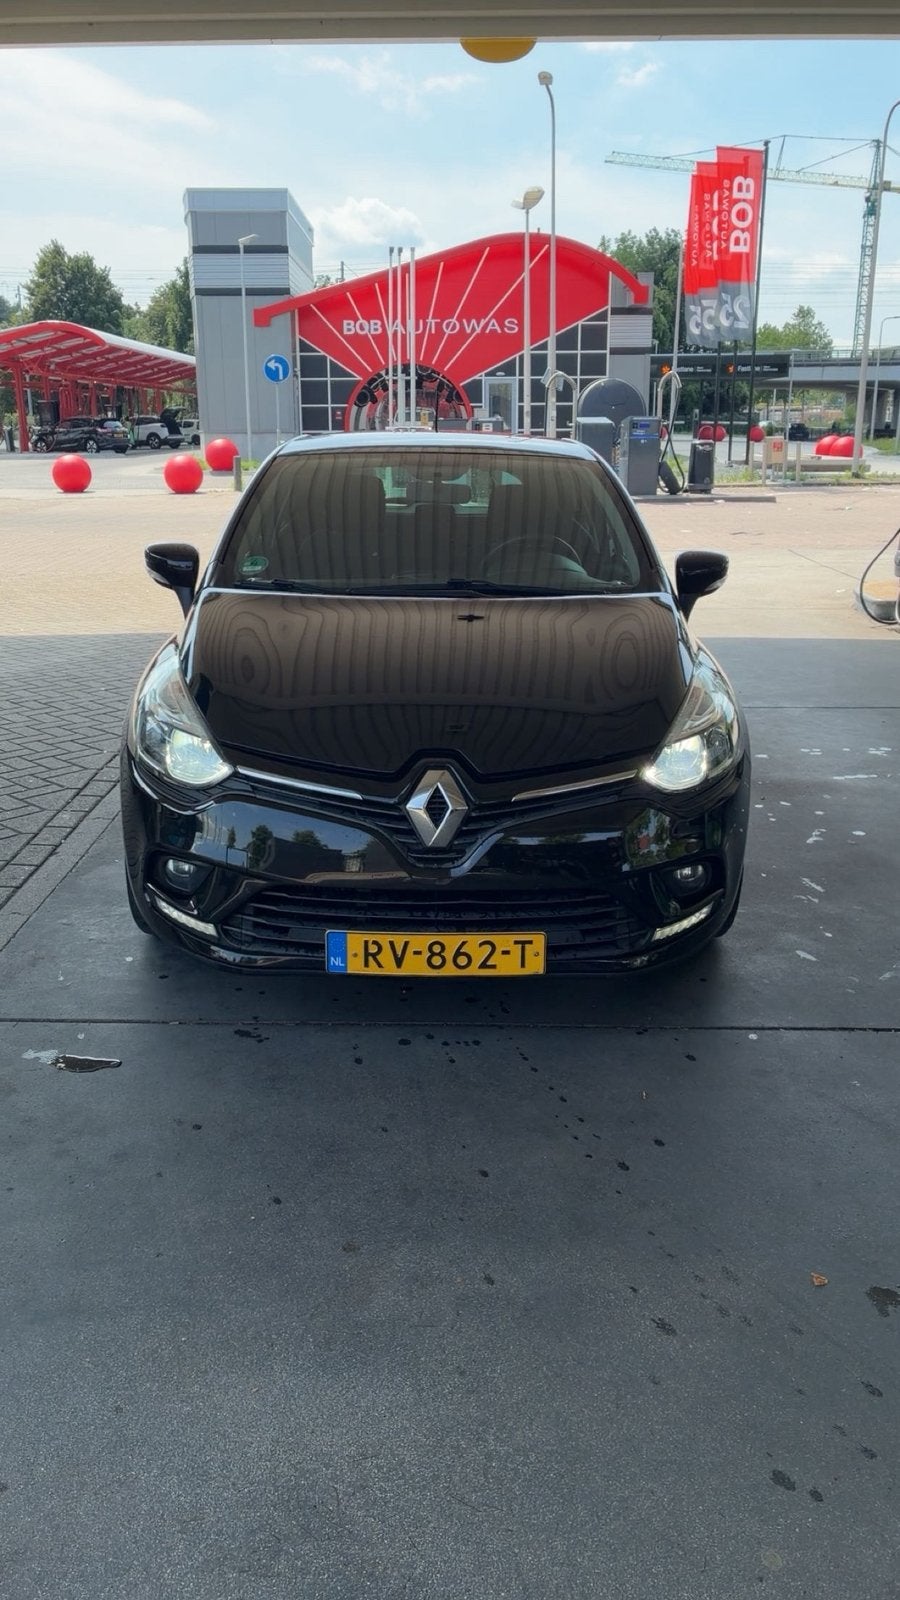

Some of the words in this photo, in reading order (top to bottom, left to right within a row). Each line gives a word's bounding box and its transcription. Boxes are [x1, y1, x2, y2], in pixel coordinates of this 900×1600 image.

[342, 319, 383, 336] BOB
[390, 318, 519, 335] AUTOWAS
[330, 957, 345, 967] NL
[362, 939, 535, 970] RV-862-T
